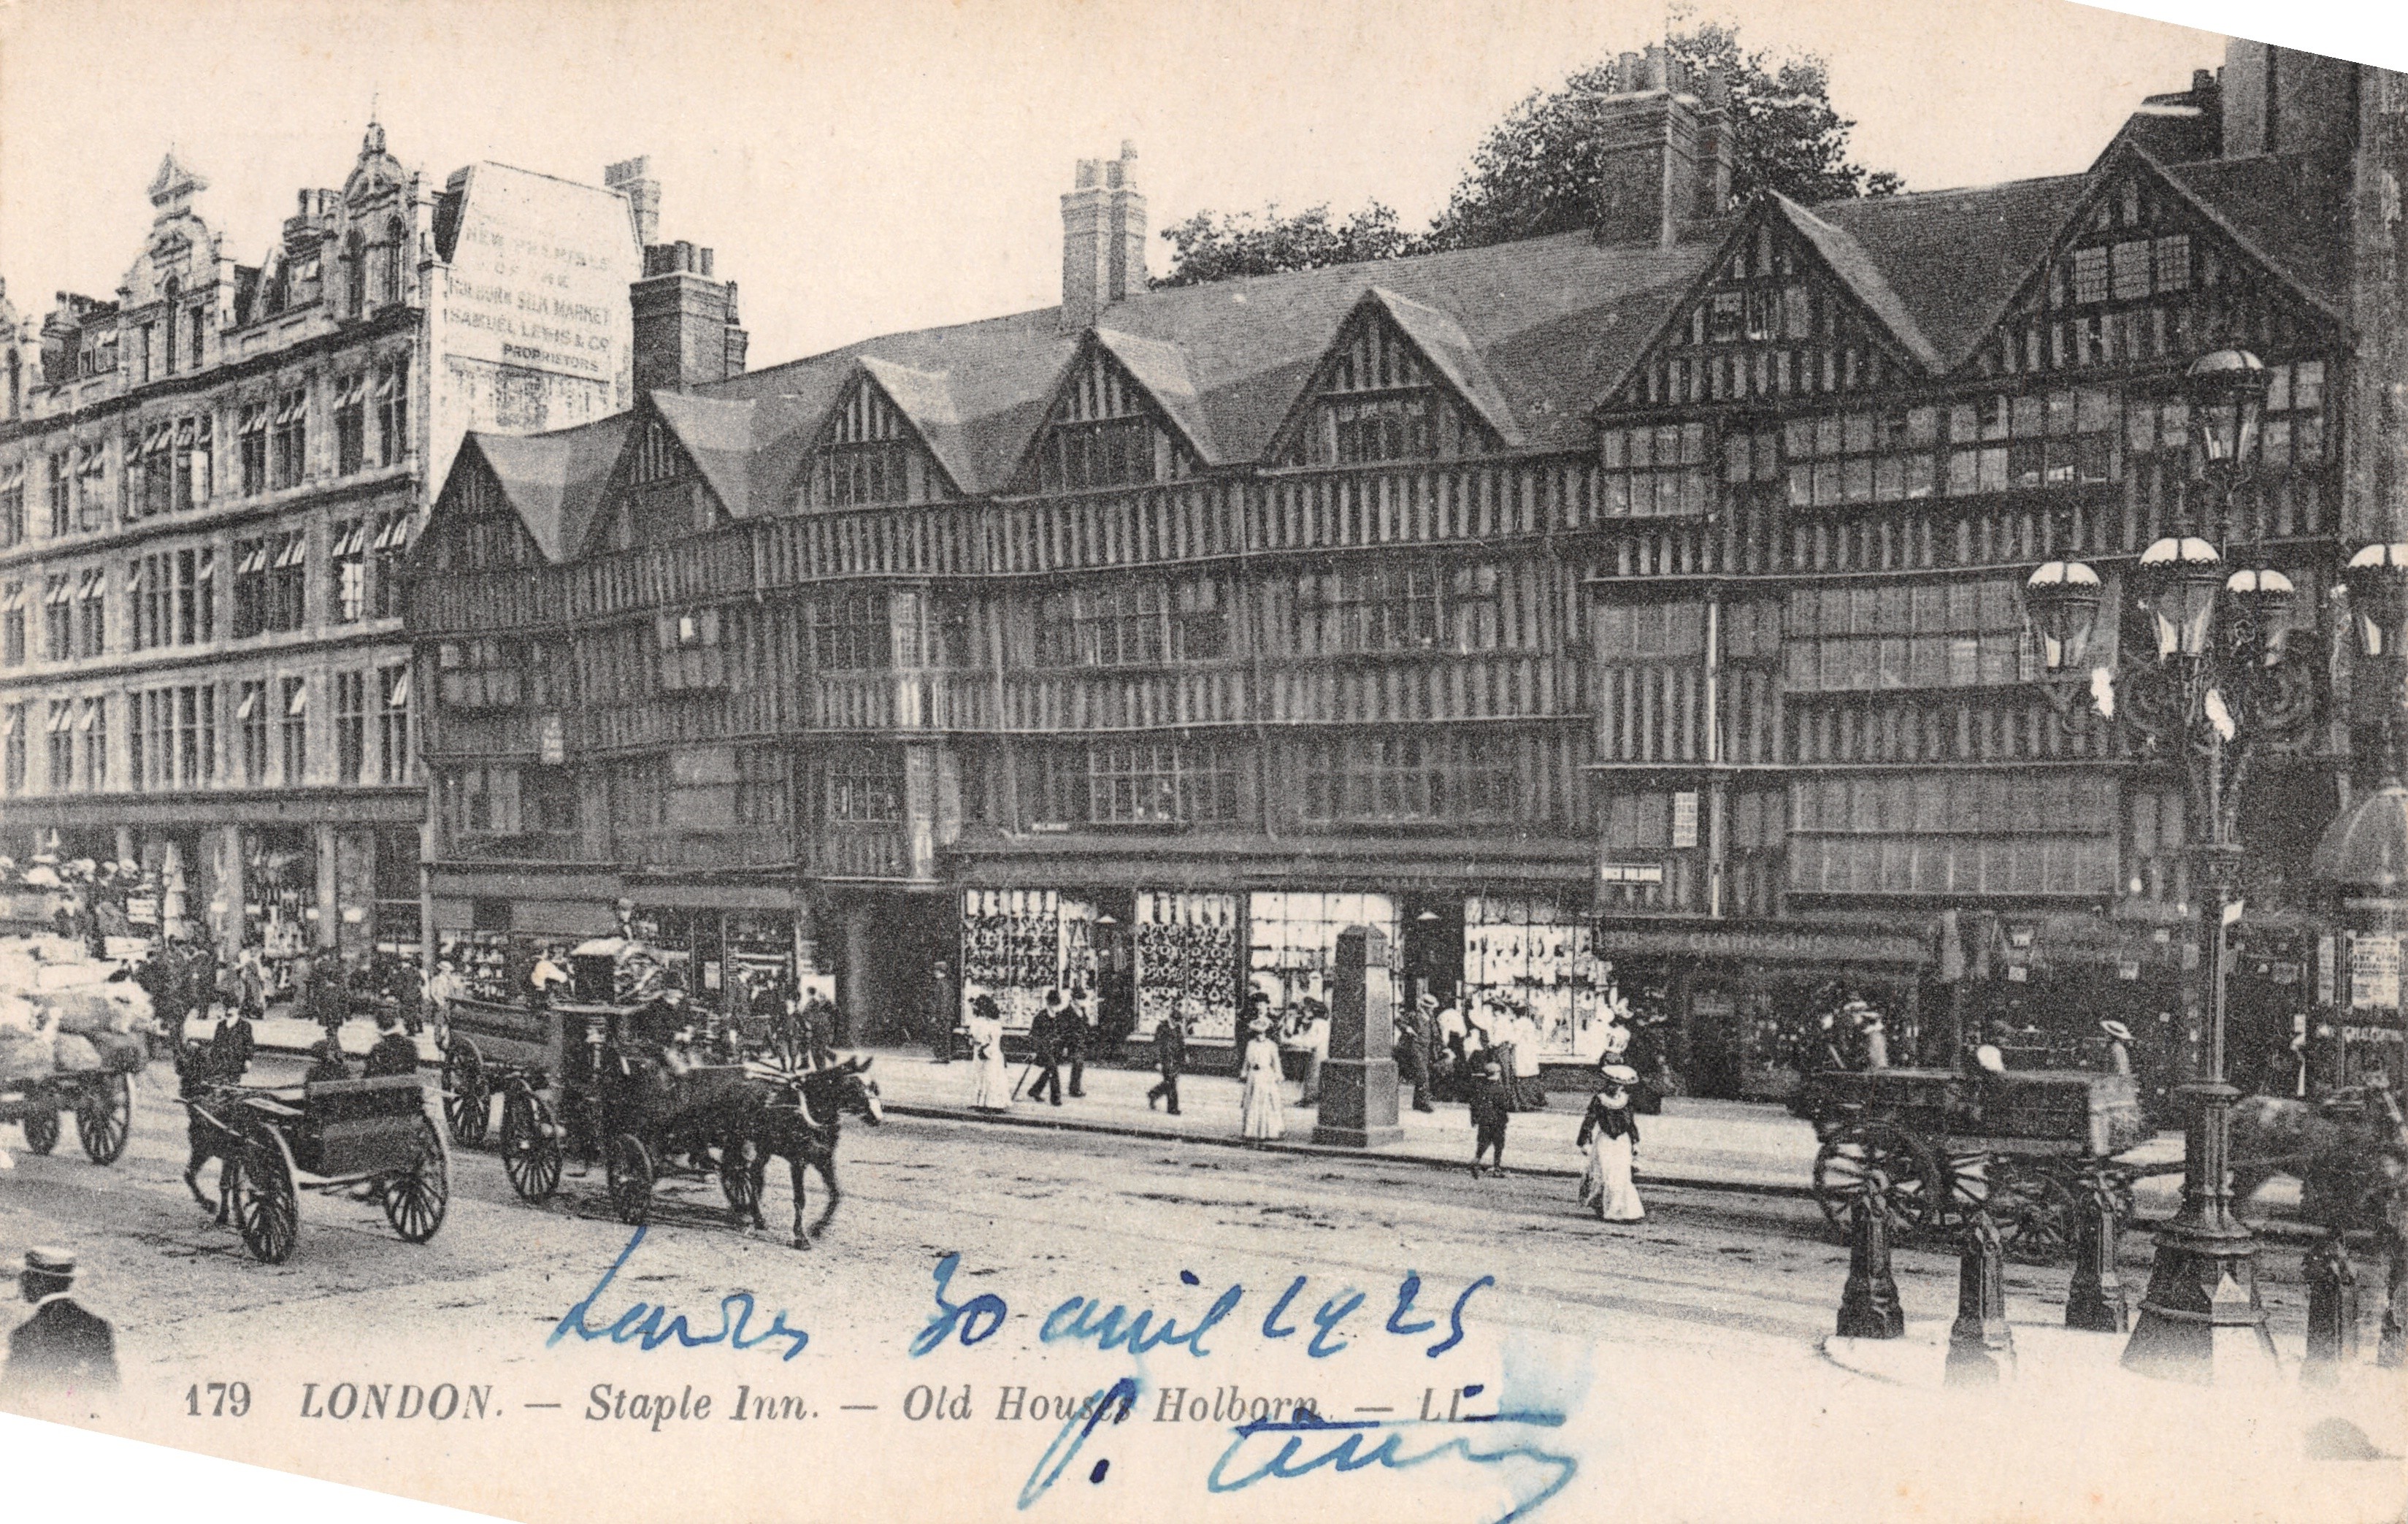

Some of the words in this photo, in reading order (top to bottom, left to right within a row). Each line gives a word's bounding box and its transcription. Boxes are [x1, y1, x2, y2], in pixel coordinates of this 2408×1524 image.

[466, 227, 505, 248] NEW
[450, 308, 515, 334] SAMUEL
[521, 322, 572, 345] LEWIS
[553, 298, 610, 326] MARKET
[503, 342, 599, 372] PROPRIETORS
